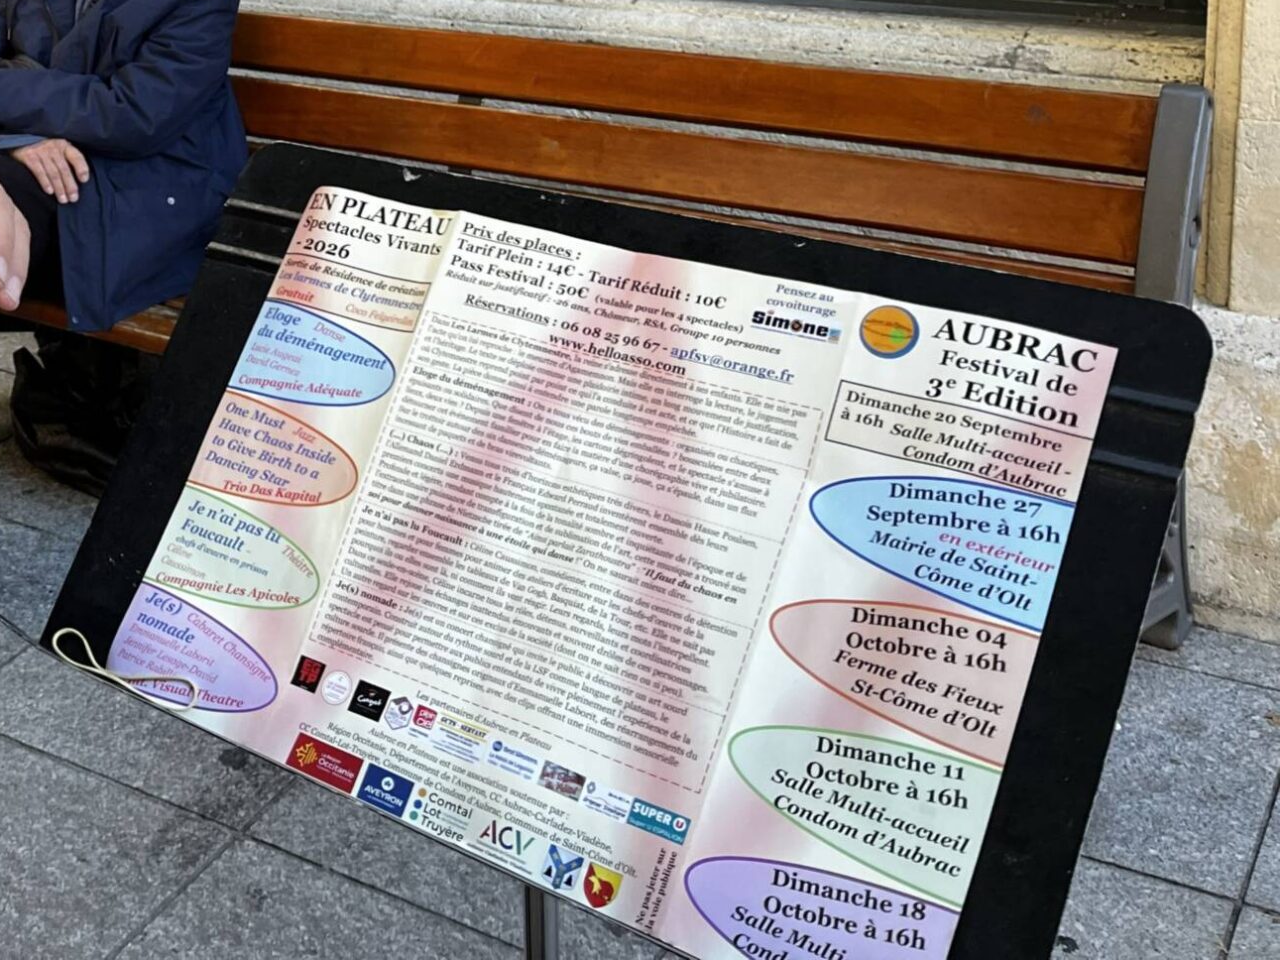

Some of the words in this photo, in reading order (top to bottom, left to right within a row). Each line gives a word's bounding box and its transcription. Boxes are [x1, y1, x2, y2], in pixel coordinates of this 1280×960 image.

[303, 216, 382, 245] Spectacles
[387, 233, 442, 256] Vivants
[309, 193, 338, 211] EN
[340, 196, 452, 237] PLATEAU
[303, 238, 351, 260] 2026
[463, 222, 492, 241] Prix
[496, 229, 521, 245] des
[523, 237, 572, 258] places
[450, 254, 483, 273] Pass
[486, 263, 546, 289] Festival
[556, 285, 590, 300] 50€
[635, 304, 660, 317] pour
[661, 307, 676, 319] les
[686, 314, 744, 335] spectacles)
[457, 239, 496, 258] Tarif
[496, 248, 534, 268] Plein
[545, 262, 576, 278] 14€
[588, 269, 631, 291] Tarif
[631, 279, 683, 303] Réduit
[694, 295, 727, 310] 10€
[775, 283, 818, 300] Pensez
[820, 293, 835, 304] au
[264, 306, 302, 327] Eloge
[312, 322, 347, 343] Danse
[765, 297, 838, 319] covoiturage
[257, 325, 272, 339] du
[275, 331, 388, 371] déménagement
[464, 293, 551, 327] Réservations
[560, 318, 580, 332] 06
[582, 325, 603, 339] 08
[603, 330, 620, 345] 25
[622, 335, 641, 349] 96
[642, 339, 662, 354] 67
[669, 345, 796, 385] apfsv@orange.fr
[548, 333, 687, 377] www.helloasso.com
[931, 317, 1098, 374] AUBRAC
[238, 373, 304, 392] Compagnie
[305, 382, 363, 400] Adéquate
[938, 349, 1039, 388] Festival
[1046, 374, 1079, 397] de
[225, 401, 251, 419] One
[250, 408, 286, 431] Must
[292, 426, 318, 444] Jazz
[845, 390, 932, 421] Dimanche
[934, 412, 958, 426] 20
[960, 414, 1063, 454] Septembre
[961, 379, 1081, 429] Edition
[212, 434, 226, 448] to
[227, 440, 257, 459] Give
[258, 449, 293, 472] Birth
[294, 462, 309, 476] to
[309, 468, 320, 481] a
[218, 417, 252, 438] Have
[253, 428, 295, 453] Chaos
[295, 444, 337, 467] Inside
[840, 407, 851, 421] à
[855, 412, 885, 430] 16h
[889, 422, 934, 443] Salle
[934, 431, 1063, 477] Multi-accueil
[205, 449, 260, 480] Dancing
[260, 468, 290, 489] Star
[902, 444, 976, 473] Condom
[977, 460, 1069, 499] d'Aubrac
[223, 479, 248, 494] Trio
[250, 483, 273, 497] Das
[274, 487, 324, 504] Kapital
[888, 481, 1008, 512] Dimanche
[1013, 498, 1044, 519] 27
[180, 518, 246, 553] Foucault
[187, 500, 205, 517] Je
[206, 506, 237, 528] n'ai
[233, 517, 265, 539] pas
[264, 526, 283, 545] lu
[281, 543, 315, 579] Théâtre
[866, 504, 992, 534] Septembre
[997, 518, 1011, 538] à
[1017, 524, 1062, 545] 16h
[869, 529, 938, 560] Mairie
[939, 547, 966, 568] de
[969, 557, 1039, 588] Saint-
[938, 531, 962, 547] en
[965, 538, 1057, 574] extérieur
[155, 570, 225, 595] Compagnie
[225, 582, 246, 597] Les
[247, 588, 302, 607] Apicoles
[913, 562, 975, 594] Côme
[977, 579, 1034, 613] d'Olt
[136, 611, 196, 645] nomade
[144, 591, 184, 616] Je(s)
[187, 611, 230, 646] Cabaret
[221, 640, 273, 684] Chansigne
[850, 606, 970, 641] Dimanche
[975, 628, 1009, 650] 04
[846, 630, 938, 661] Octobre
[943, 645, 958, 665] à
[964, 651, 1008, 674] 16h
[152, 678, 195, 698] Visual
[196, 688, 245, 709] Theatre
[832, 648, 899, 682] Ferme
[900, 670, 939, 695] des
[941, 683, 1005, 718] Fieux
[850, 678, 940, 720] St-Côme
[942, 709, 1000, 740] d'Olt
[815, 735, 937, 776] Dimanche
[943, 763, 966, 781] 11
[364, 785, 405, 808] AVEYRON
[428, 792, 474, 820] Comtal
[805, 760, 900, 797] Octobre
[905, 780, 919, 800] à
[925, 787, 970, 810] 16h
[419, 815, 465, 843] Truyère
[423, 803, 442, 820] Lot
[631, 801, 673, 827] SUPER
[771, 767, 825, 800] Salle
[827, 789, 971, 855] Multi-accueil
[479, 819, 536, 856] ACV
[656, 847, 667, 864] sur
[773, 793, 860, 841] Condom
[861, 831, 964, 879] d'Aubrac
[646, 864, 662, 888] jeter
[650, 896, 663, 918] voie
[657, 851, 678, 896] publique
[770, 868, 894, 914] Dimanche
[898, 900, 928, 922] 18
[635, 908, 649, 925] Ne
[641, 889, 654, 908] pas
[730, 904, 785, 940] Salle
[763, 895, 859, 935] Octobre
[864, 918, 878, 940] à
[883, 928, 927, 951] 16h
